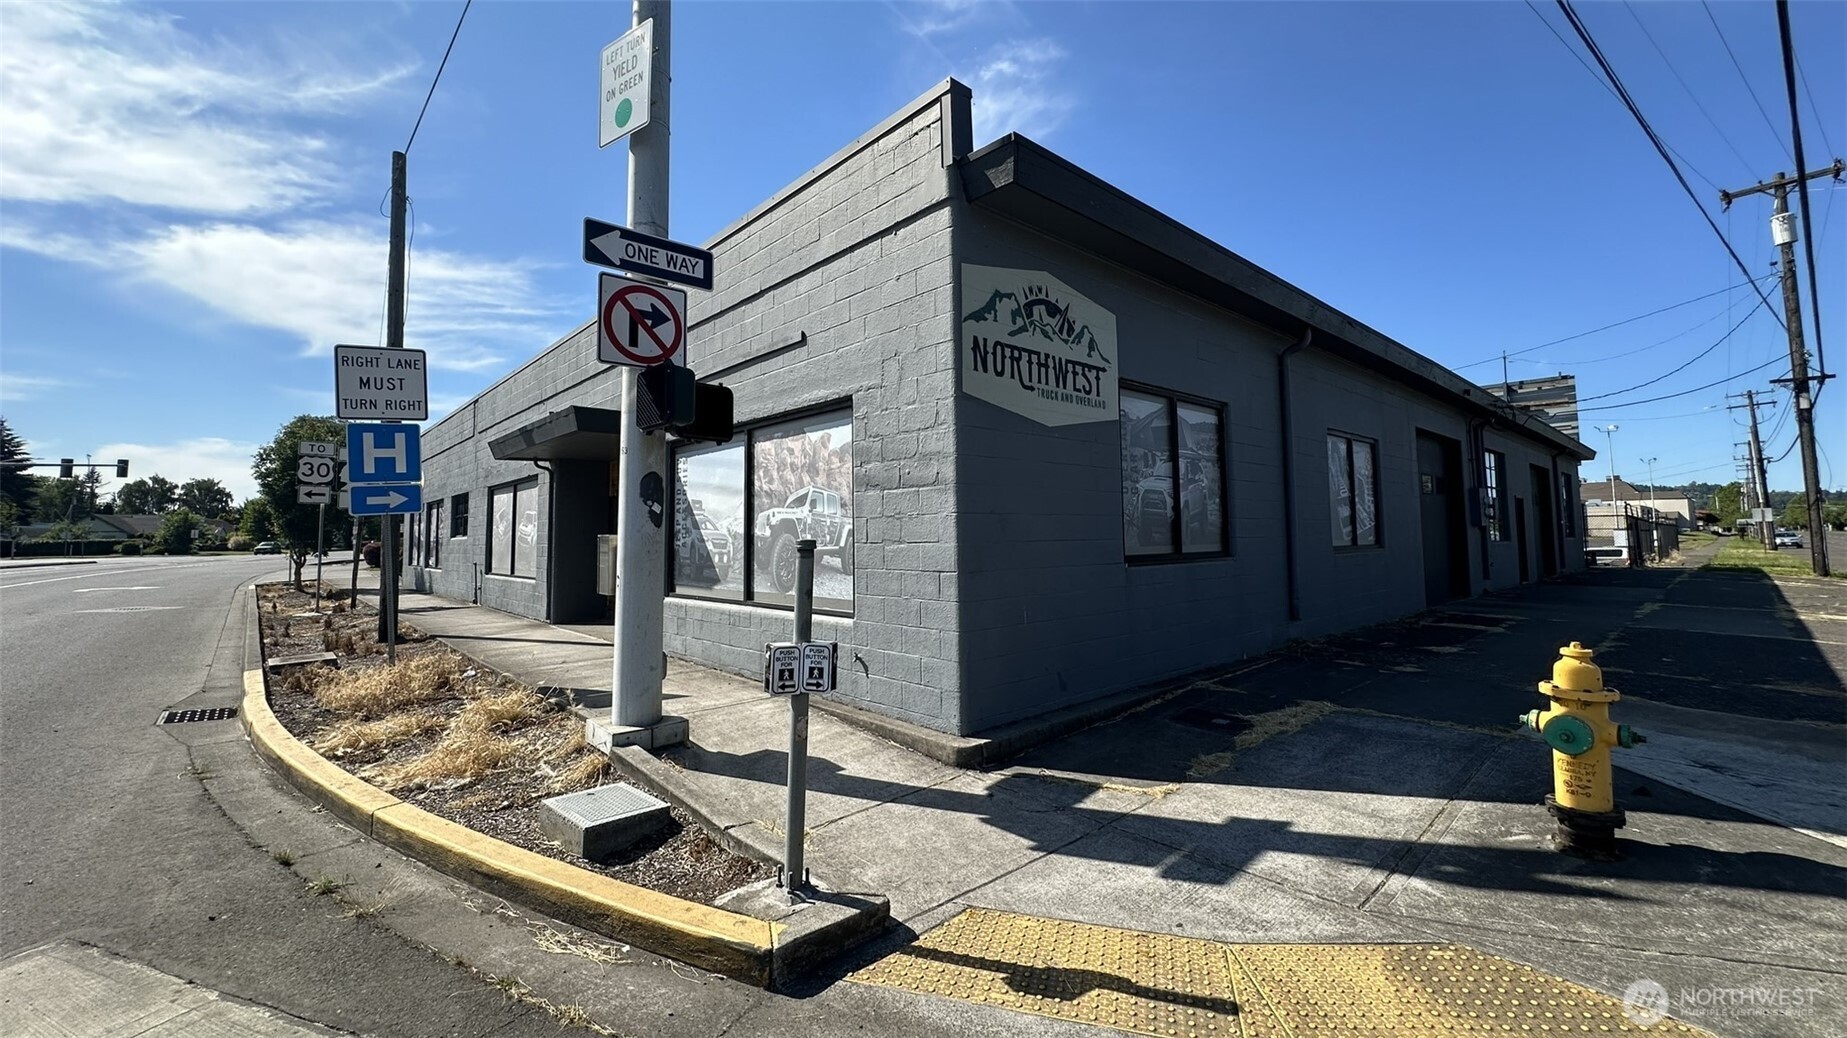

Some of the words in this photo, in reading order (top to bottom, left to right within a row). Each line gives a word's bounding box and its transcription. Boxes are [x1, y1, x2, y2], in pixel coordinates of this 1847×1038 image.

[606, 47, 624, 66] LEFT
[626, 32, 646, 53] TURN
[612, 54, 638, 81] YIELD
[606, 87, 616, 102] ON
[619, 70, 644, 96] GREEN
[625, 243, 660, 266] ONE
[666, 252, 699, 274] WAY
[341, 355, 381, 368] RIGHT
[388, 357, 421, 370] LANE
[971, 335, 1107, 398] NORTHWEST
[359, 376, 405, 391] MUST
[342, 398, 378, 410] TURN
[385, 399, 423, 411] RIGHT
[1037, 387, 1058, 402] TRUCK
[1061, 392, 1074, 404] AND
[1075, 394, 1106, 410] OVERLAND
[309, 443, 326, 453] TO
[363, 432, 407, 474] H
[301, 461, 331, 478] 30
